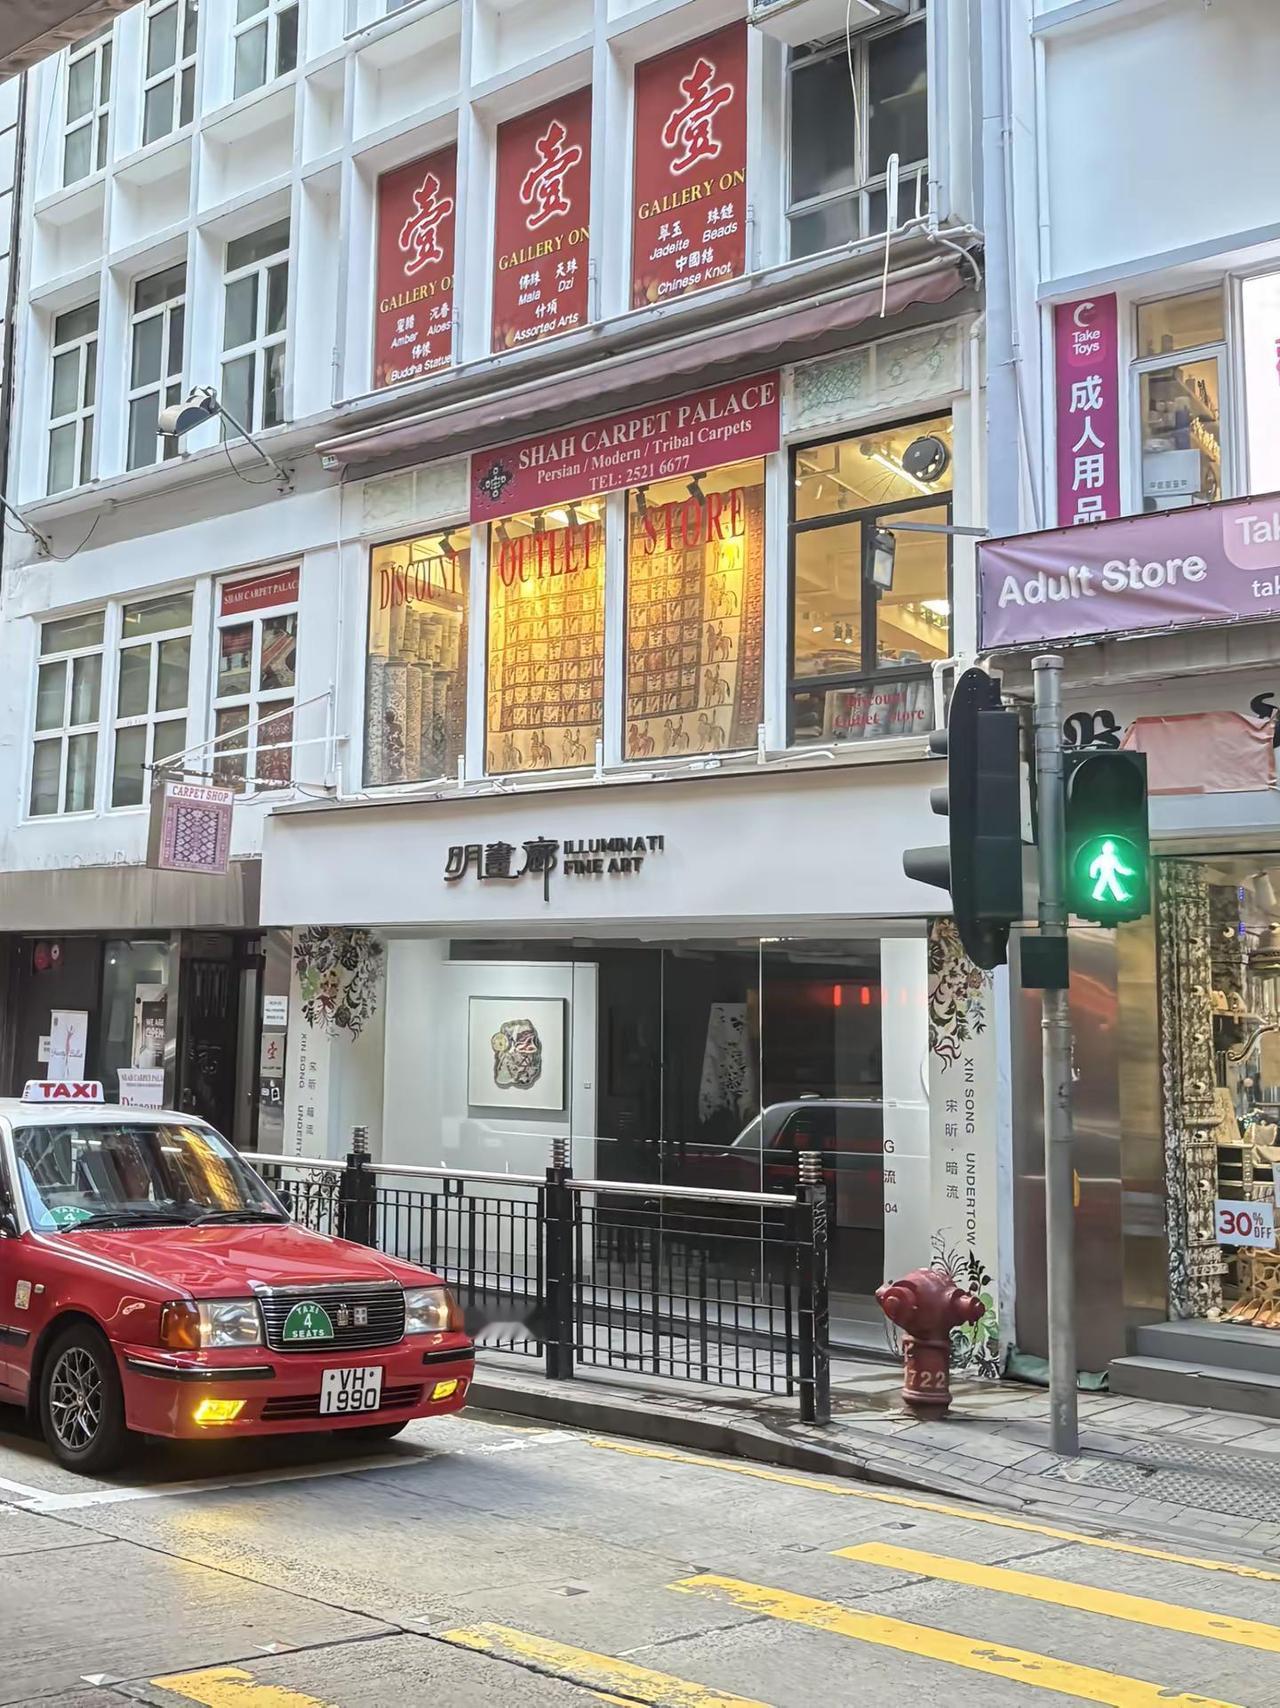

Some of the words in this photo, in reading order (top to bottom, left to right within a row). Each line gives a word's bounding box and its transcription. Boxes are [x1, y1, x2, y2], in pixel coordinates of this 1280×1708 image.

[638, 179, 714, 219] GALLERY
[702, 222, 738, 242] Beads
[499, 234, 563, 270] GALLERY
[649, 239, 690, 260] Jadeite
[558, 277, 574, 292] Dzi
[657, 272, 701, 295] Chinese
[704, 262, 732, 280] Knot
[380, 280, 437, 313] GALLERY
[514, 320, 556, 342] Assorted
[558, 313, 579, 327] Arts
[1072, 330, 1100, 343] Take
[391, 332, 418, 348] Amber
[1072, 342, 1100, 356] Toys
[391, 363, 422, 381] Buddha
[519, 436, 575, 469] SHAH
[580, 412, 671, 452] CARPET
[678, 382, 776, 428] PALACE
[537, 462, 581, 484] Persian
[591, 447, 640, 470] Modern
[652, 433, 694, 455] Tribal
[697, 419, 752, 444] Carpets
[589, 473, 622, 491] TEL:
[626, 464, 654, 483] 2521
[659, 455, 690, 475] 6677
[644, 487, 745, 556] STORE
[998, 565, 1094, 608] Adult
[1102, 555, 1207, 592] Store
[244, 586, 272, 600] CARPET
[173, 785, 205, 799] CARPET
[206, 789, 229, 802] SHOP
[563, 835, 665, 855] ILLUMINATI
[563, 858, 603, 875] FINE
[608, 857, 644, 874] ART
[964, 1057, 974, 1083] XIN
[39, 1083, 97, 1098] TAXI
[965, 1088, 975, 1134] SONG
[966, 1153, 976, 1245] UNDERTOW
[1254, 1226, 1272, 1239] OFF
[296, 1305, 319, 1315] TAXI
[304, 1313, 312, 1328] 4
[292, 1329, 325, 1338] SEATS
[340, 1368, 366, 1390] VH
[327, 1388, 377, 1412] 1990
